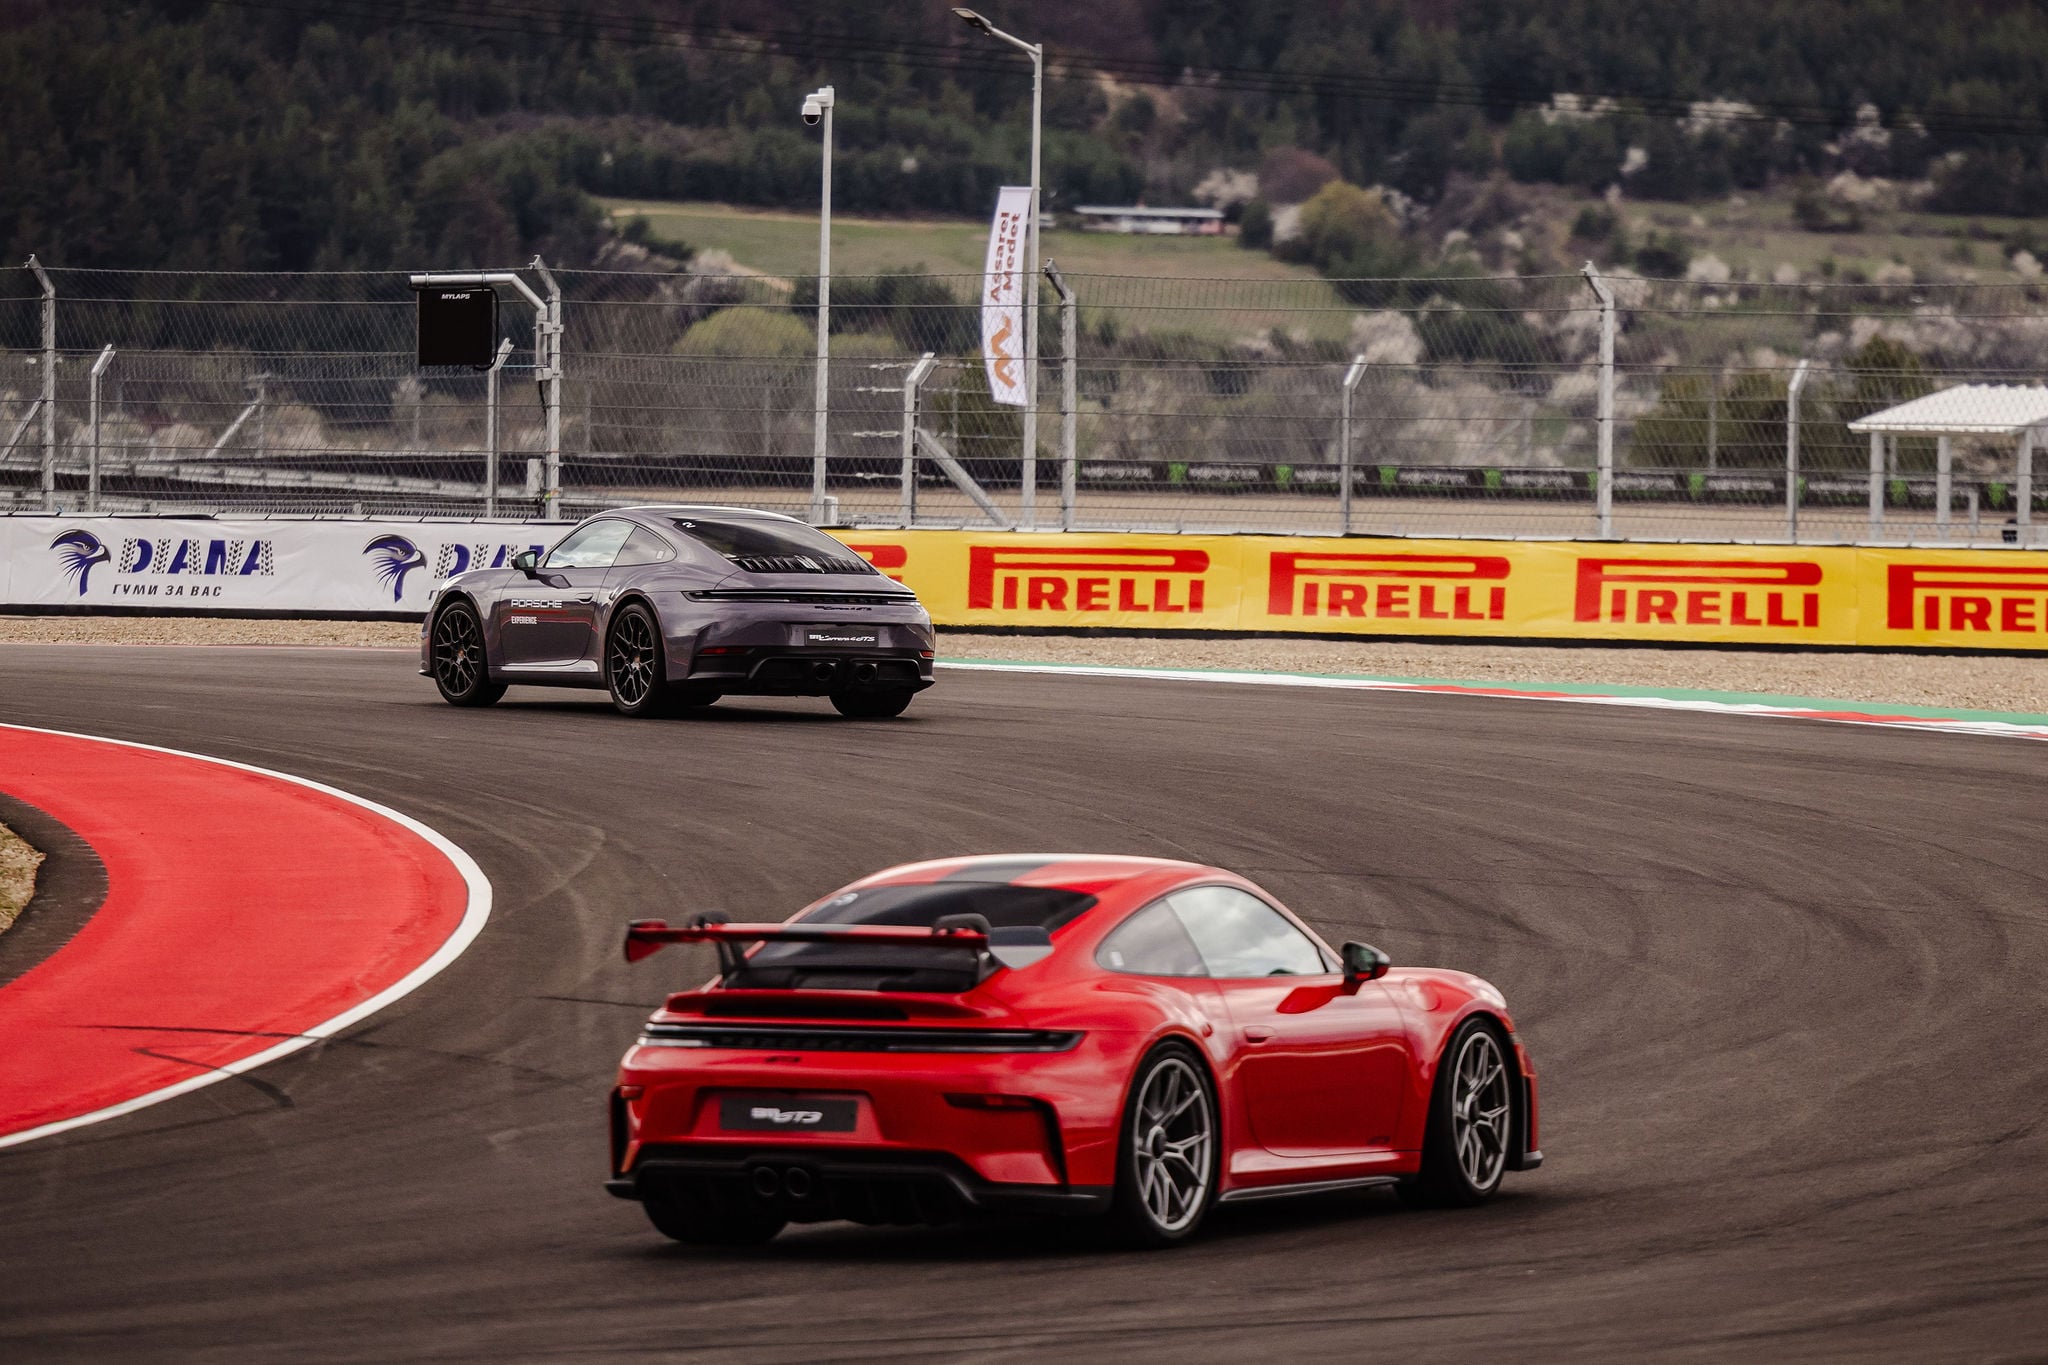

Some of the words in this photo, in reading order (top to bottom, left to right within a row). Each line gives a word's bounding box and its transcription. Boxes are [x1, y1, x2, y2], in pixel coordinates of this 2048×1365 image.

[990, 211, 1010, 303] Assarel
[1002, 212, 1021, 291] Medet
[112, 584, 159, 595] ГУМИ
[165, 585, 184, 596] ЗА
[190, 586, 223, 597] ВАС
[118, 538, 275, 576] DIANA
[434, 543, 545, 579] DIA
[967, 546, 1209, 613] PIRELLI
[1267, 551, 1511, 621] PIRELLI
[511, 599, 563, 608] PORSCHE
[511, 616, 538, 624] EXPERIENCE
[1573, 558, 1823, 628] PIRELLI
[1886, 563, 2048, 634] PIRE
